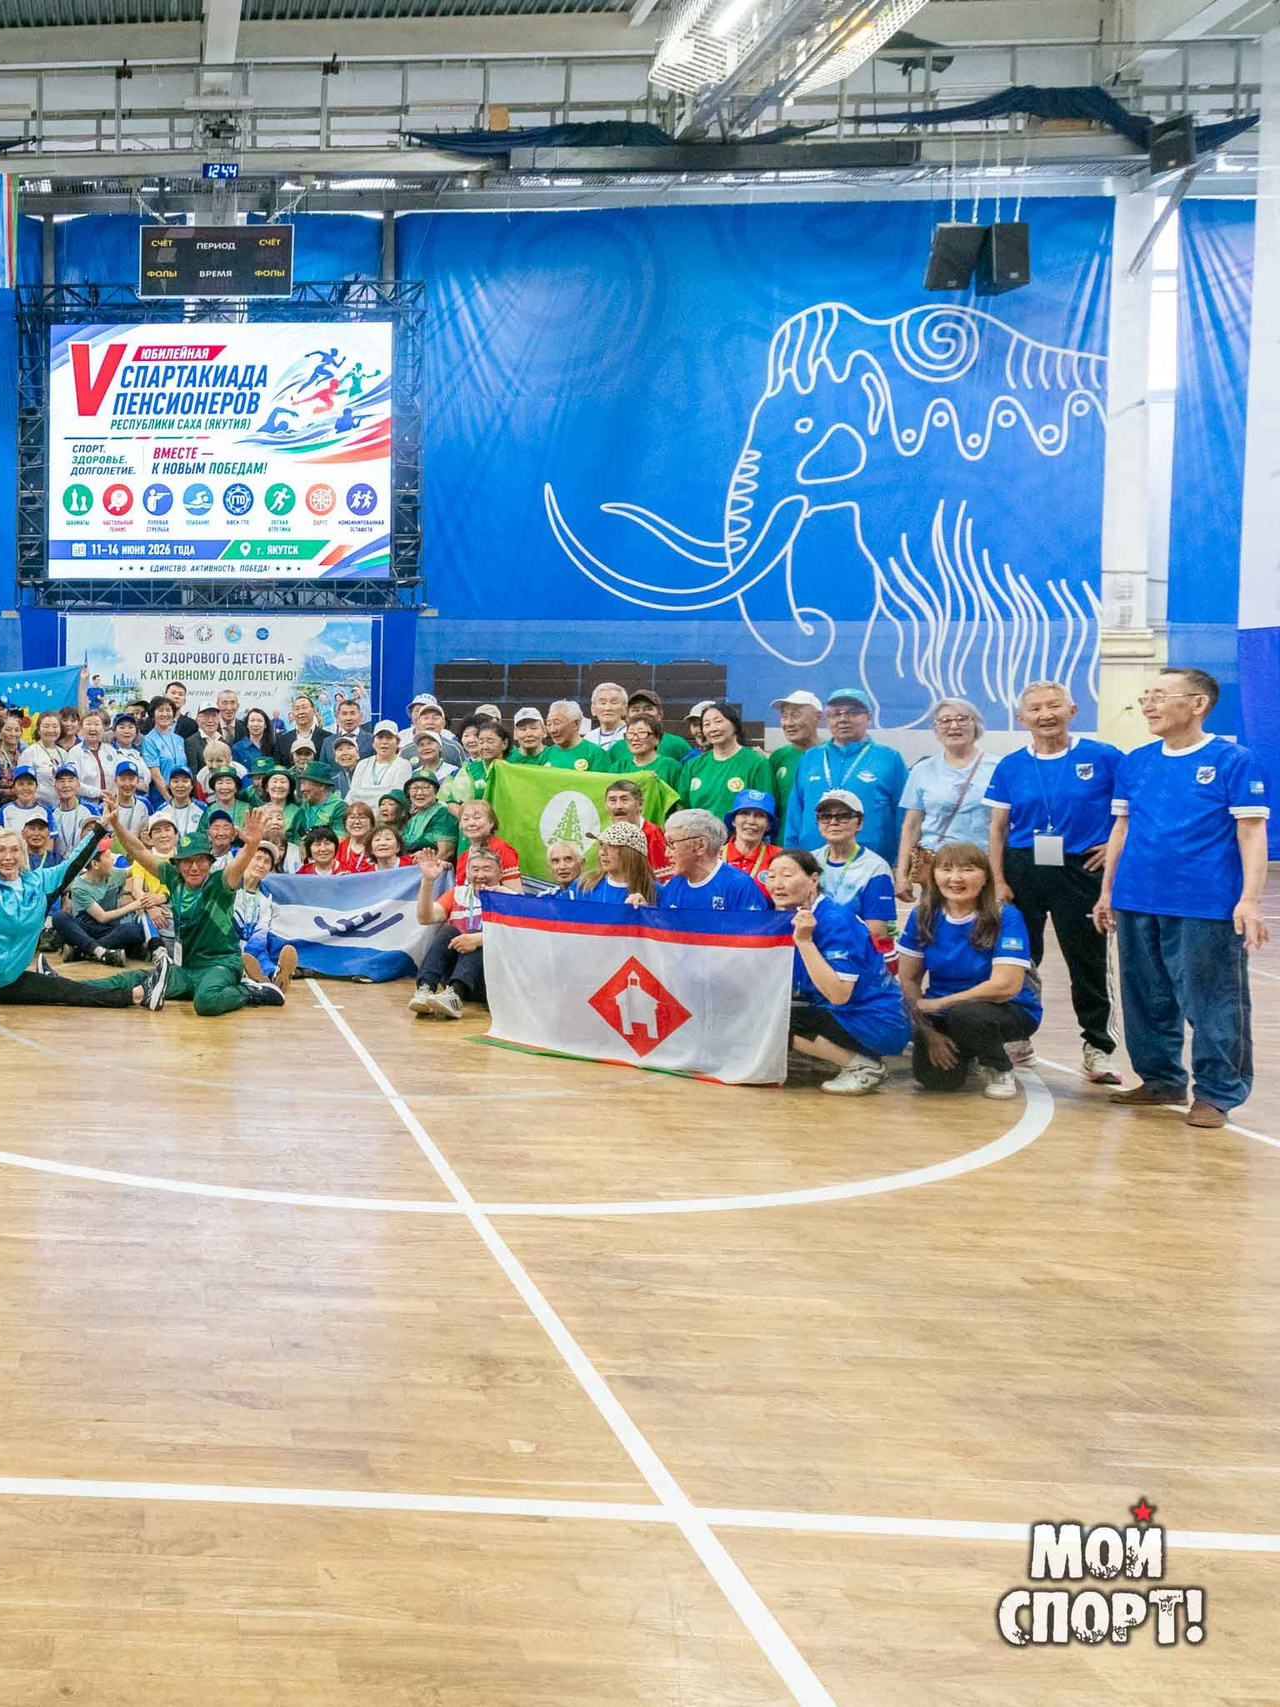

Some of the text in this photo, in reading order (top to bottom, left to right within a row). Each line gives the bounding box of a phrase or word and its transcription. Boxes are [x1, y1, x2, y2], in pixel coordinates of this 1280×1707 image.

[196, 242, 236, 251] ПЕРИОД
[147, 270, 177, 278] ФОЛЫ
[199, 270, 233, 278] ВРЕМЯ
[254, 269, 286, 277] ФОЛЫ
[141, 346, 209, 360] ЮБИЛЕЙНАЯ
[71, 343, 128, 416] V
[120, 365, 267, 390] СПАРТАКИАДА
[112, 392, 260, 415] ПЕНСИОНЕРОВ
[110, 418, 251, 431] РЕСПУБЛИКИ САХА (ЯКУТИЯ)
[72, 444, 105, 453] СПОРТ.
[153, 447, 198, 459] ВМЕСТЕ
[71, 455, 128, 465] ЗДОРОВЬЕ.
[70, 466, 136, 476] ДОЛГОЛЕТИЕ.
[151, 462, 268, 476] К НОВЫМ ПОБЕДАМ!
[231, 495, 246, 505] ГТО
[148, 544, 170, 555] 2026
[267, 544, 299, 555] ЯКУТСК
[145, 652, 159, 664] ОТ
[162, 652, 230, 665] ЗДОРОВОГО
[232, 653, 284, 665] ДЕТСТВА
[140, 669, 297, 682] К АКТИВНОМУ ДОЛГОЛЕТИЮ!
